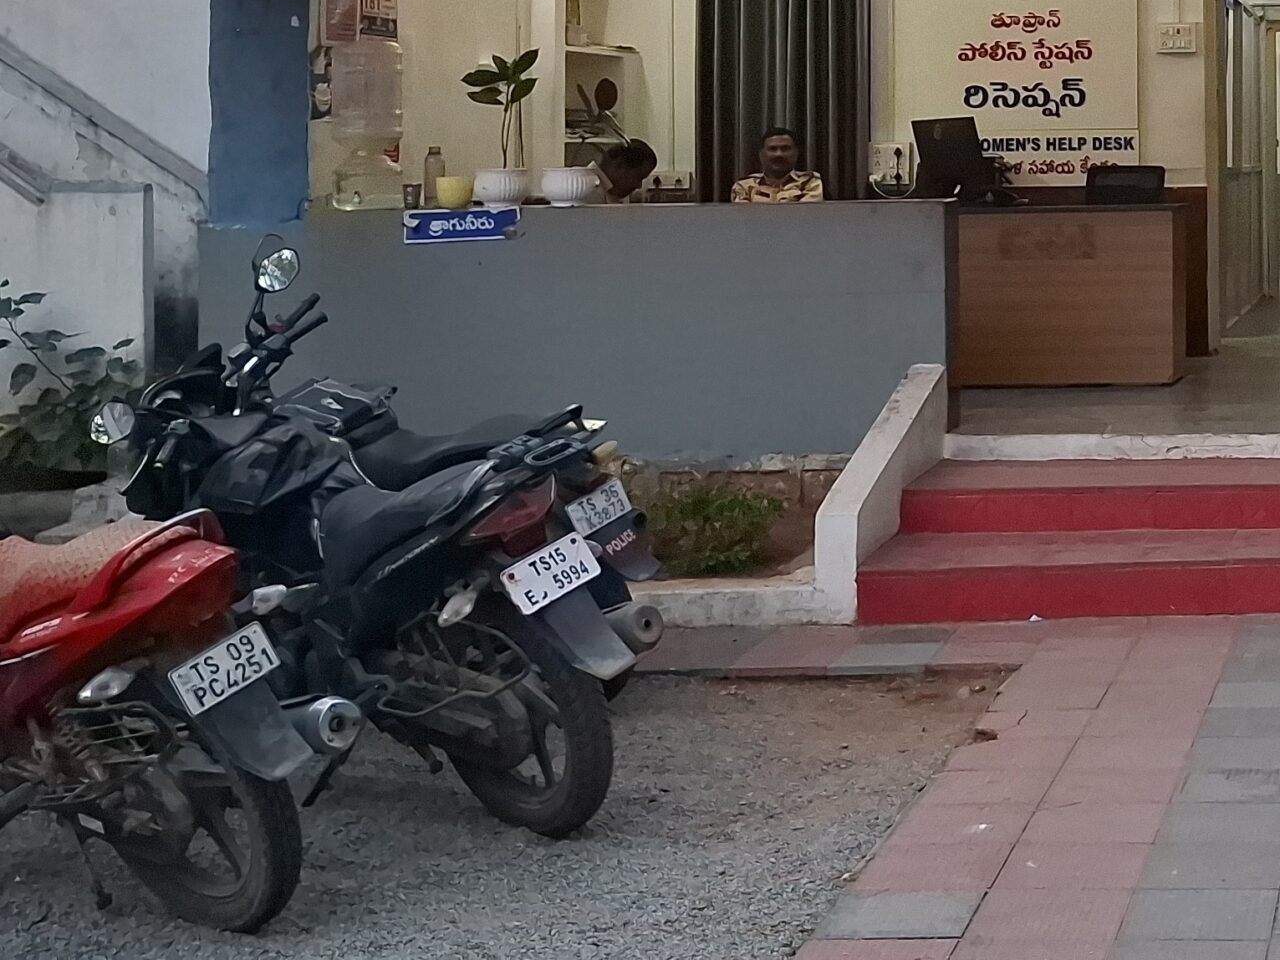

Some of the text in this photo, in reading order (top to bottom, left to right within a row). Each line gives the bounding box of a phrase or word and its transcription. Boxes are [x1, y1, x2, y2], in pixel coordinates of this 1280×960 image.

[990, 9, 1061, 33] తూప్రాన్
[957, 38, 1093, 69] పోలీస్ స్టేషన్
[963, 78, 1087, 118] రిసెప్షన్
[980, 136, 1135, 152] OMEN'S HELP DESK
[578, 496, 597, 516] TS
[605, 528, 637, 556] POLICE
[527, 546, 568, 577] TS15
[552, 559, 590, 590] 5994
[188, 634, 255, 683] TS 09
